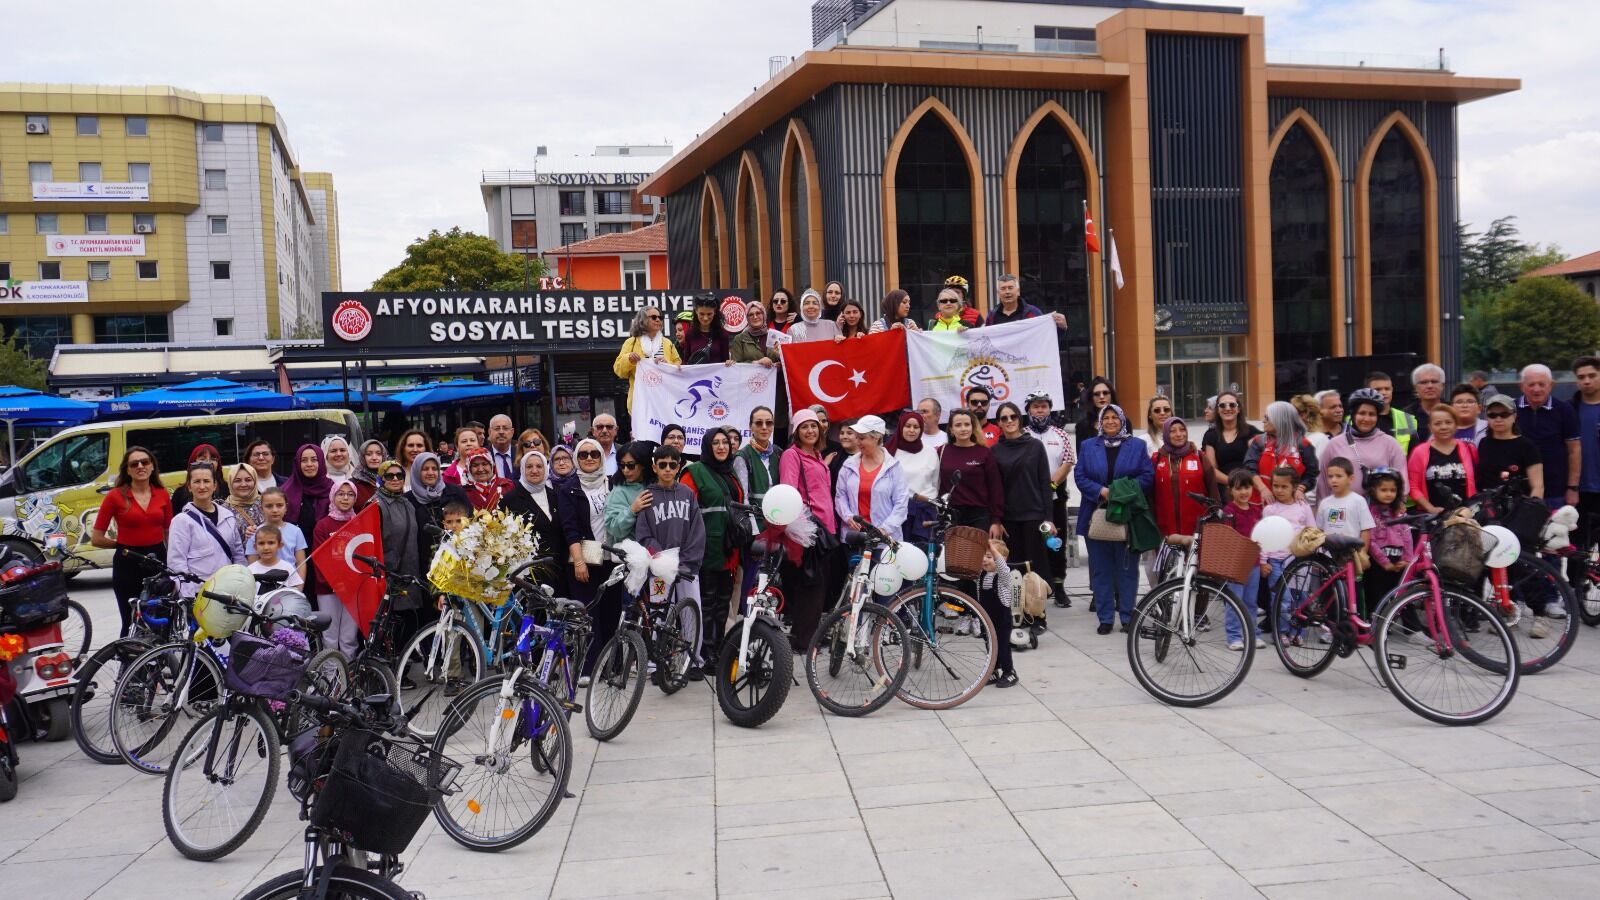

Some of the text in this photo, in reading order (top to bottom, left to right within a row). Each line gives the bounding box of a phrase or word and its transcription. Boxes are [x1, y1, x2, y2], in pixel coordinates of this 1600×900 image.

[550, 173, 608, 185] SOYDAN
[539, 277, 567, 290] T.C.
[376, 292, 695, 316] AFYONKARAHİSAR BELEDİYE
[430, 315, 671, 342] SOSYAL TESİSLİ
[652, 498, 691, 526] MAVİ
